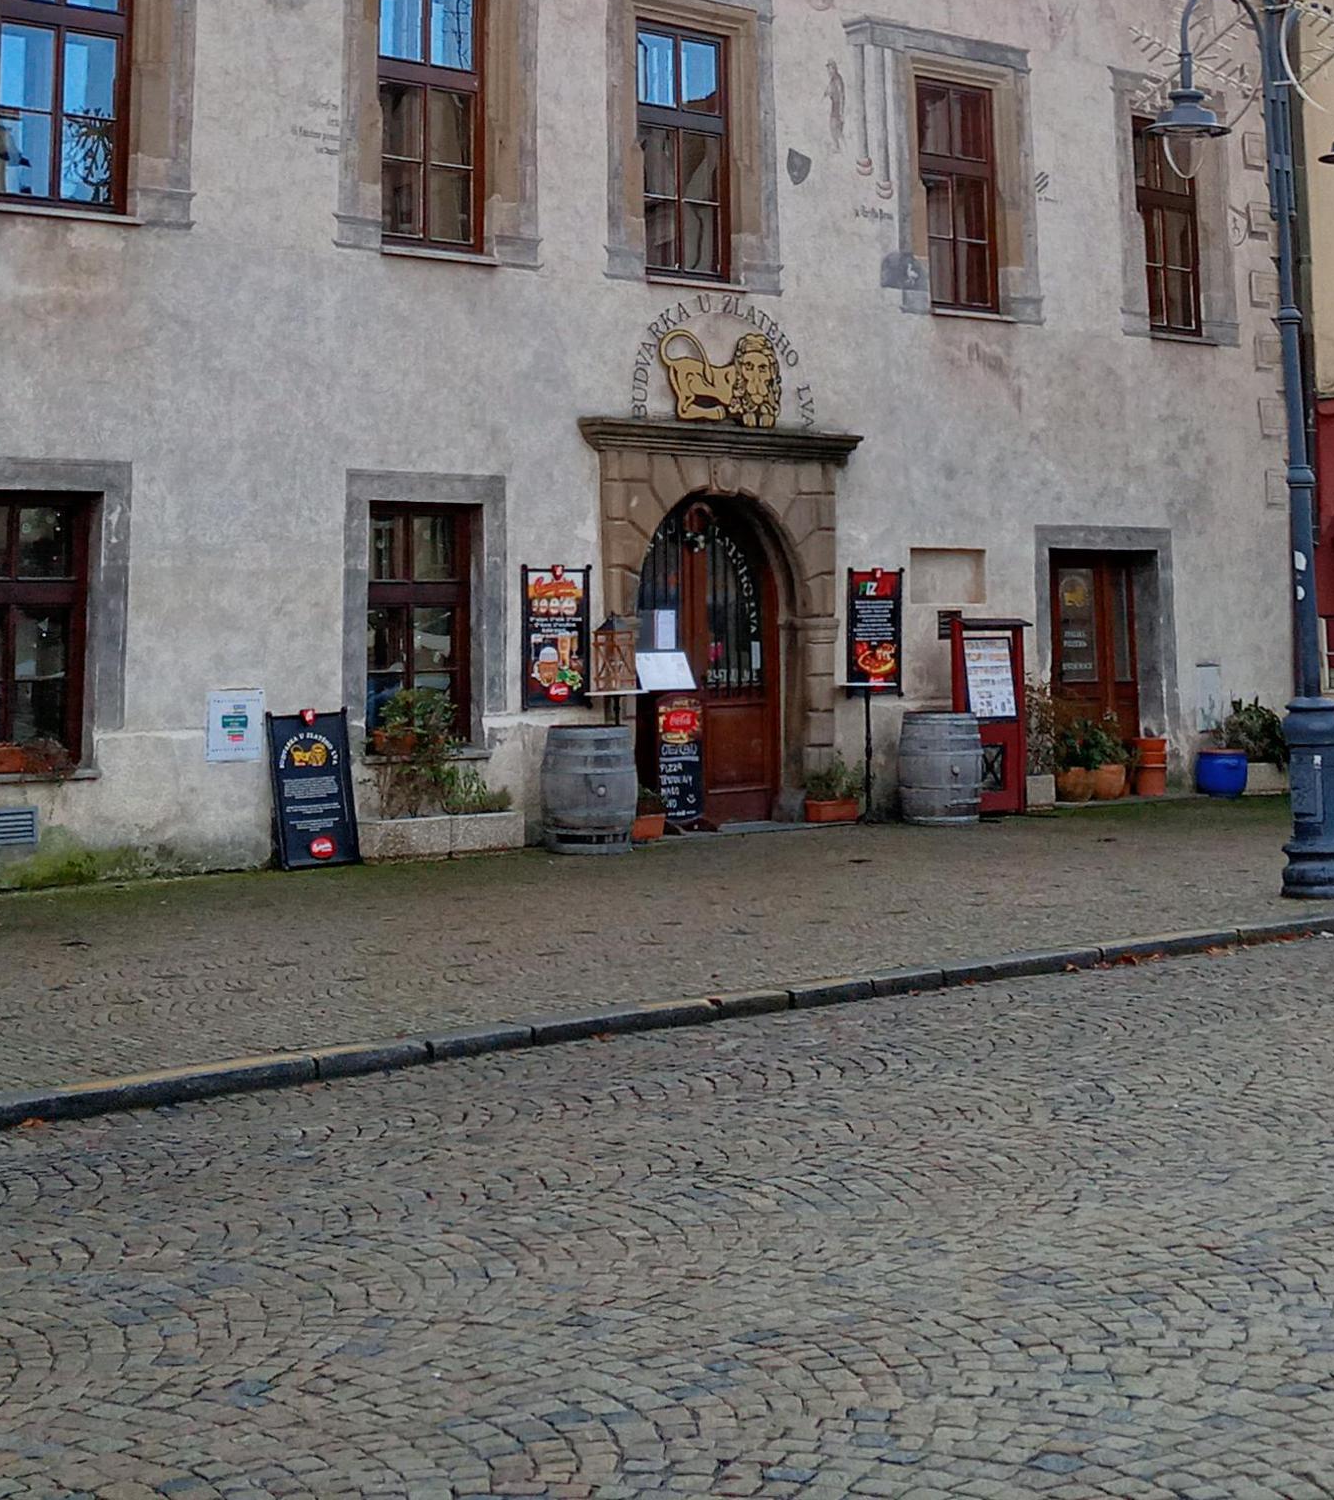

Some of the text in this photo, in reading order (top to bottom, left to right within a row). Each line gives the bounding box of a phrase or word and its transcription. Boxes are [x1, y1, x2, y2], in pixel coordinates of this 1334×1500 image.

[632, 293, 816, 428] BUDVARKA U ZLATÉHO LVA
